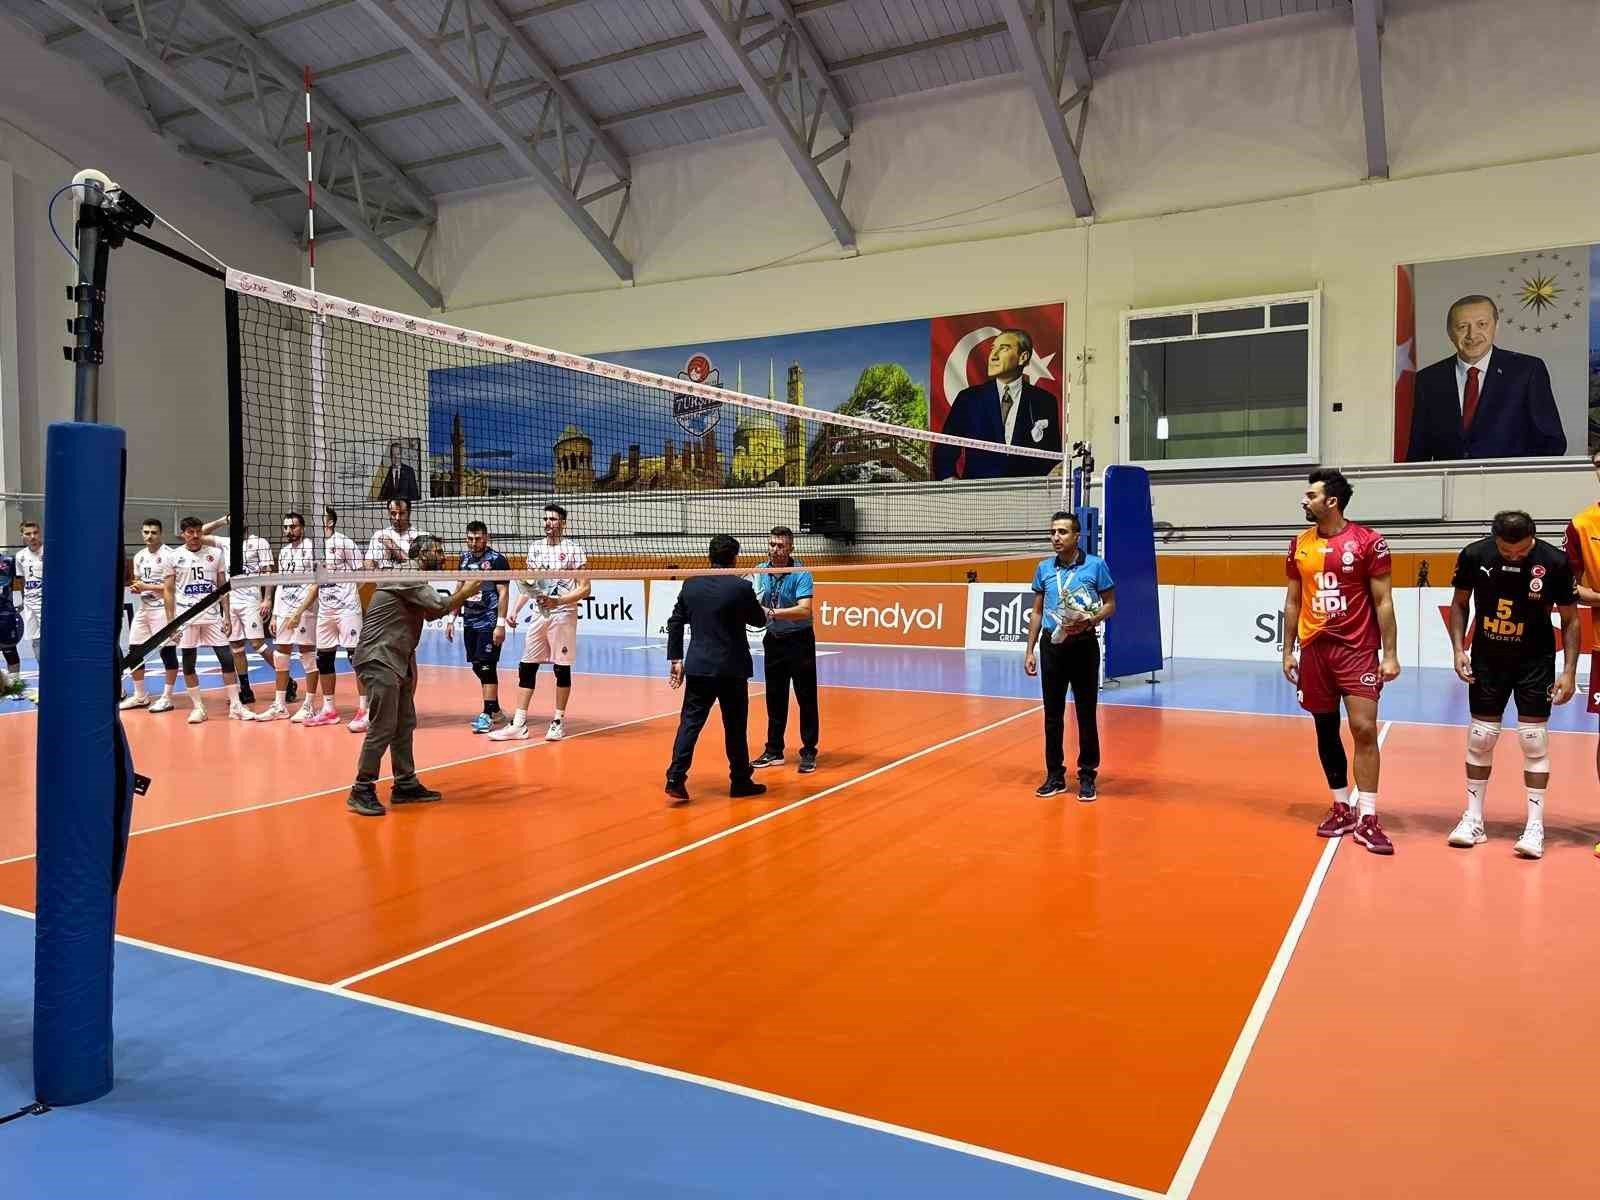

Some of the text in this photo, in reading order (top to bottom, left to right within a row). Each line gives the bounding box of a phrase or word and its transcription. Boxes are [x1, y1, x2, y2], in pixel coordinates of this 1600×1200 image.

[191, 566, 205, 581] 15
[1313, 571, 1338, 590] 10
[576, 596, 634, 621] cTurk
[1311, 595, 1348, 612] HDI
[1496, 598, 1513, 620] 5
[820, 600, 944, 635] trendyol
[1483, 616, 1524, 636] HDI
